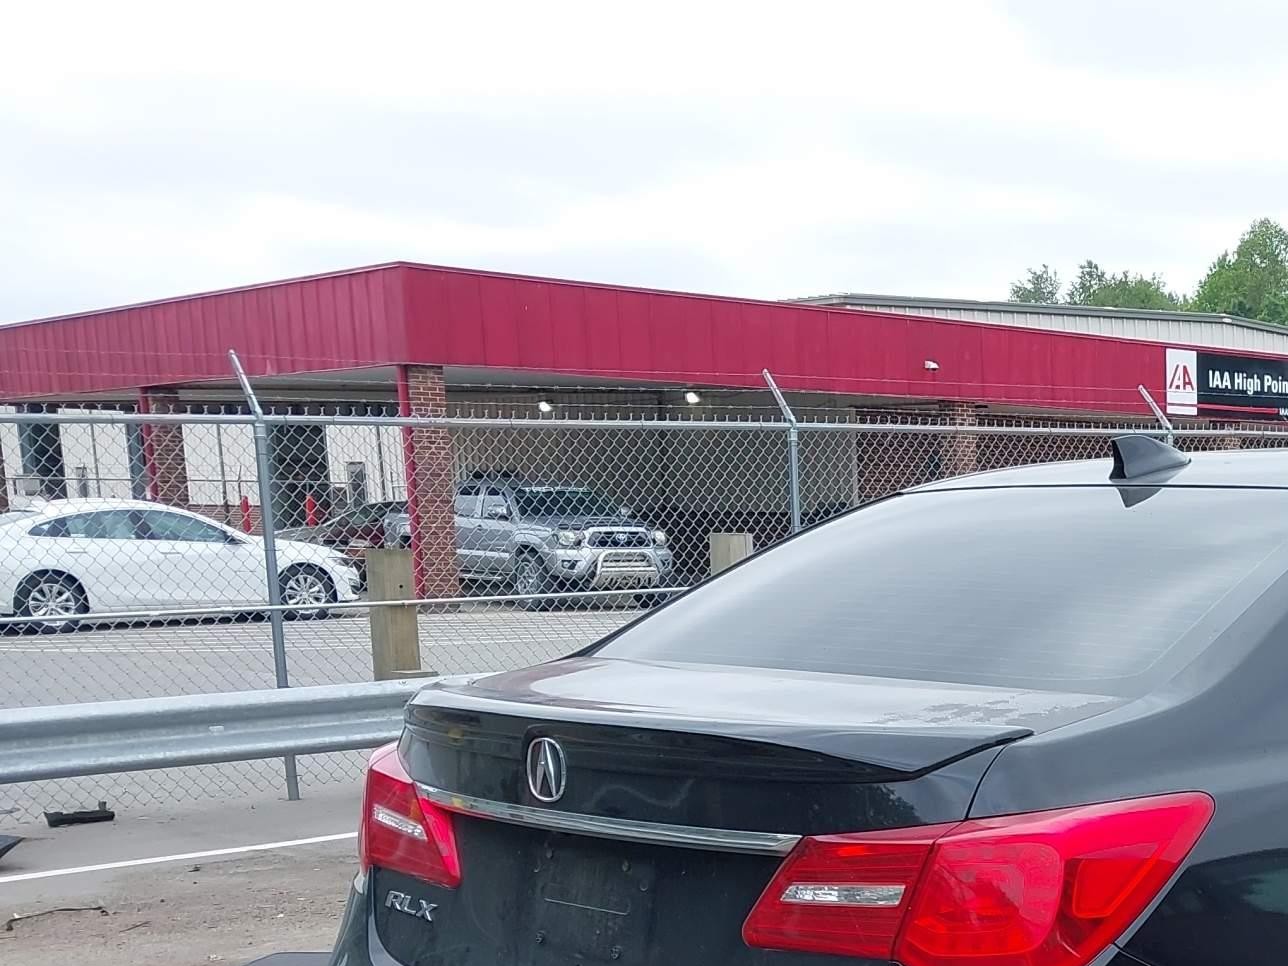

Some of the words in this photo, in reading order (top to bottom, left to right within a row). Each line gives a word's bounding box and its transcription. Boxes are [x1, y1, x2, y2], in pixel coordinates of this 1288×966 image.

[1208, 369, 1232, 390] IAA
[1234, 372, 1261, 395] High
[385, 890, 438, 921] RLX
